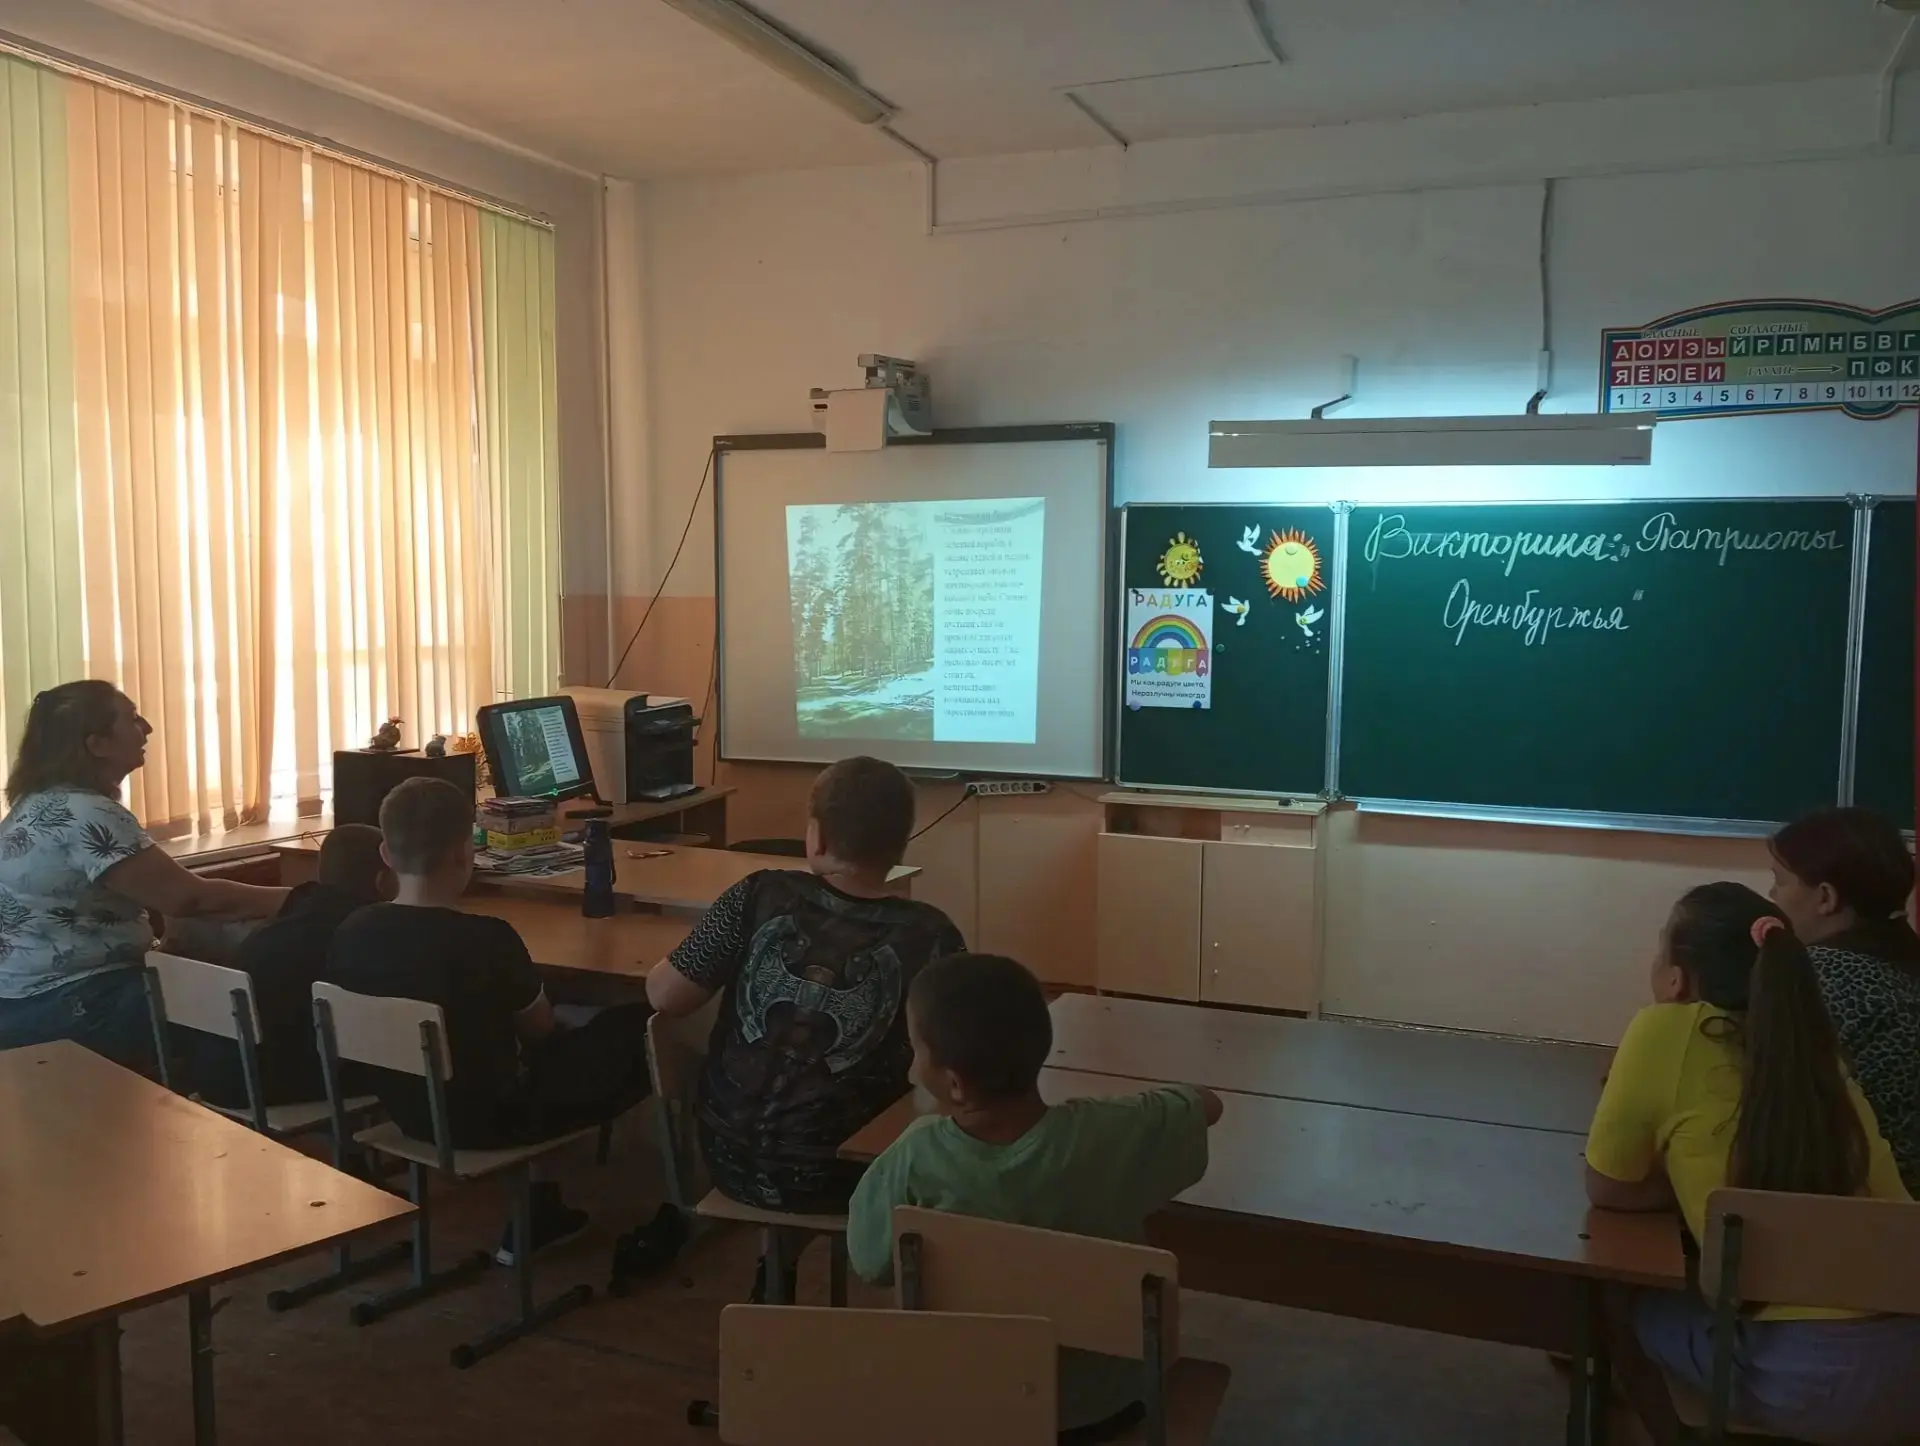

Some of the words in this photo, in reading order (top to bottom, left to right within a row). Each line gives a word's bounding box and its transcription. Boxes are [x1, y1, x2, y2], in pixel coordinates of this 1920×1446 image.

[1615, 346, 1629, 359] А
[1638, 344, 1652, 358] О
[1663, 343, 1675, 357] У
[1685, 342, 1699, 356] Э
[1706, 340, 1725, 356] Ы
[1732, 337, 1746, 354] Й
[1758, 340, 1770, 353] Р
[1780, 338, 1794, 352] Л
[1804, 338, 1820, 352] М
[1829, 337, 1843, 351] Н
[1853, 336, 1868, 350] Б
[1878, 335, 1892, 349] В
[1904, 334, 1916, 348] Г
[1615, 369, 1629, 383] Я
[1638, 366, 1650, 382] Ё
[1658, 368, 1678, 382] Ю
[1685, 366, 1697, 380] Е
[1708, 366, 1720, 380] И
[1851, 361, 1864, 375] П
[1874, 360, 1891, 374] Ф
[1901, 360, 1913, 374] К
[1617, 393, 1624, 405] 1
[1642, 392, 1652, 404] 2
[1668, 392, 1676, 404] 3
[1693, 391, 1704, 403] 4
[1720, 390, 1730, 402] 5
[1745, 389, 1754, 401] 6
[1774, 388, 1784, 400] 7
[1798, 388, 1808, 400] 8
[1826, 386, 1836, 398] 9
[1849, 386, 1866, 398] 10
[1877, 385, 1893, 398] 11
[1135, 593, 1208, 609] РАДУГА
